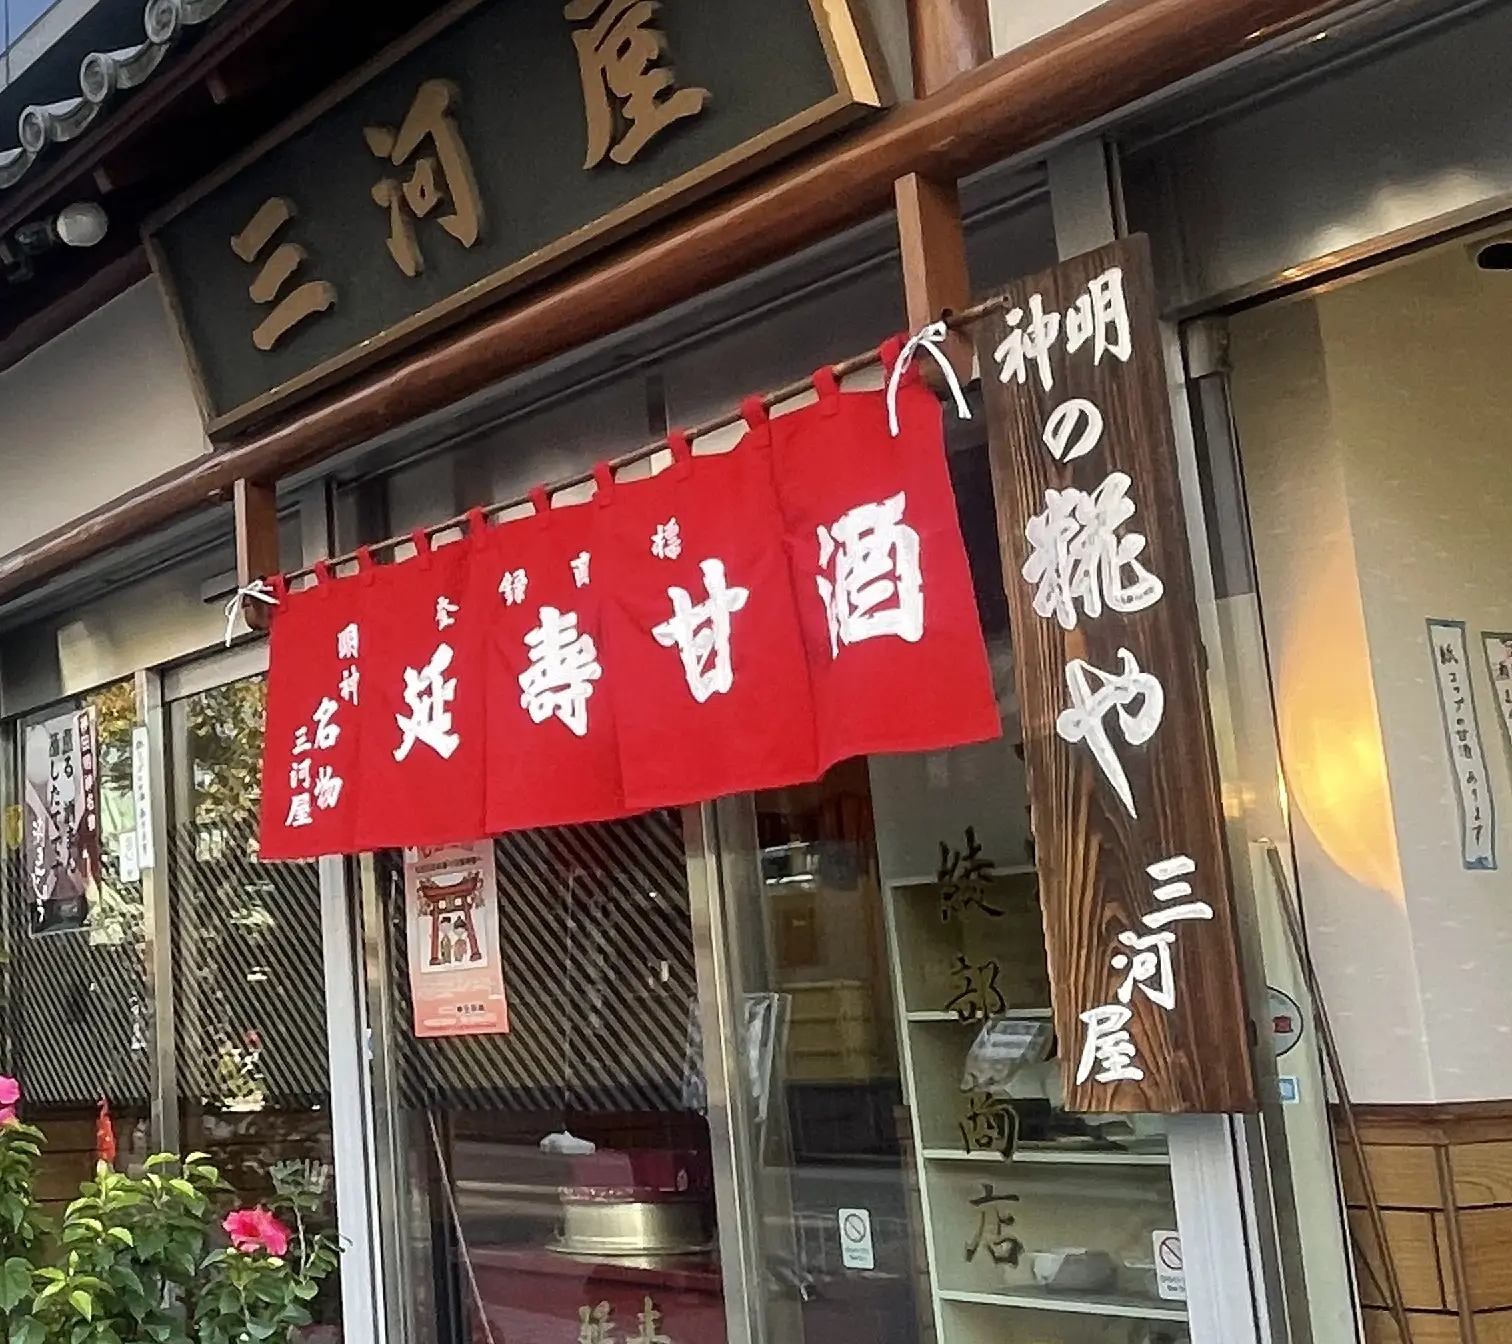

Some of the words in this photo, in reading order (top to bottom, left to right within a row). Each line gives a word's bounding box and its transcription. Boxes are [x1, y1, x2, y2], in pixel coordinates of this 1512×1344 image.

[284, 726, 313, 828] 三河屋
[1074, 856, 1213, 1087] 三河屋
